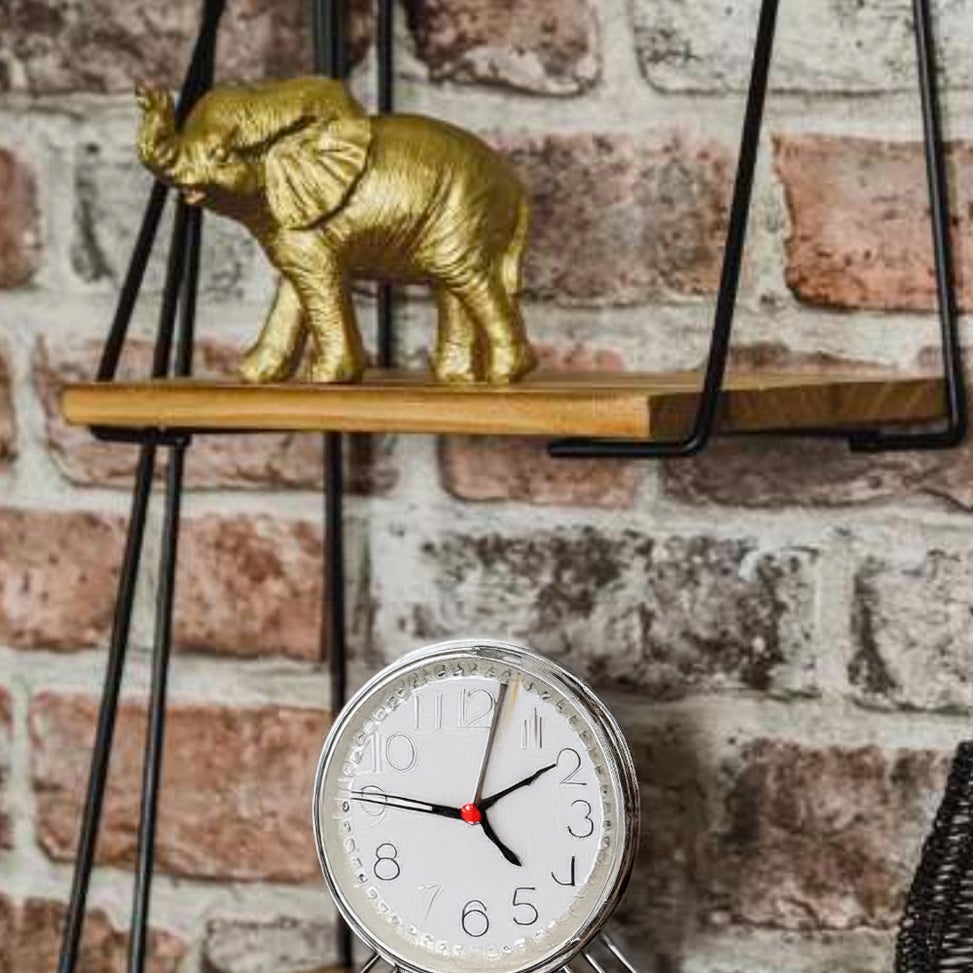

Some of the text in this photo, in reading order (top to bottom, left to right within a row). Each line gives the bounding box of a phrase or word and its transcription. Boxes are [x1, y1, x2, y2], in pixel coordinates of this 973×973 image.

[458, 687, 496, 729] 12
[363, 730, 416, 773] 10
[556, 748, 588, 786] 2
[568, 799, 594, 839] 3
[373, 842, 401, 881] 8
[416, 884, 445, 921] 7
[461, 899, 490, 938] 6
[513, 886, 539, 926] 5
